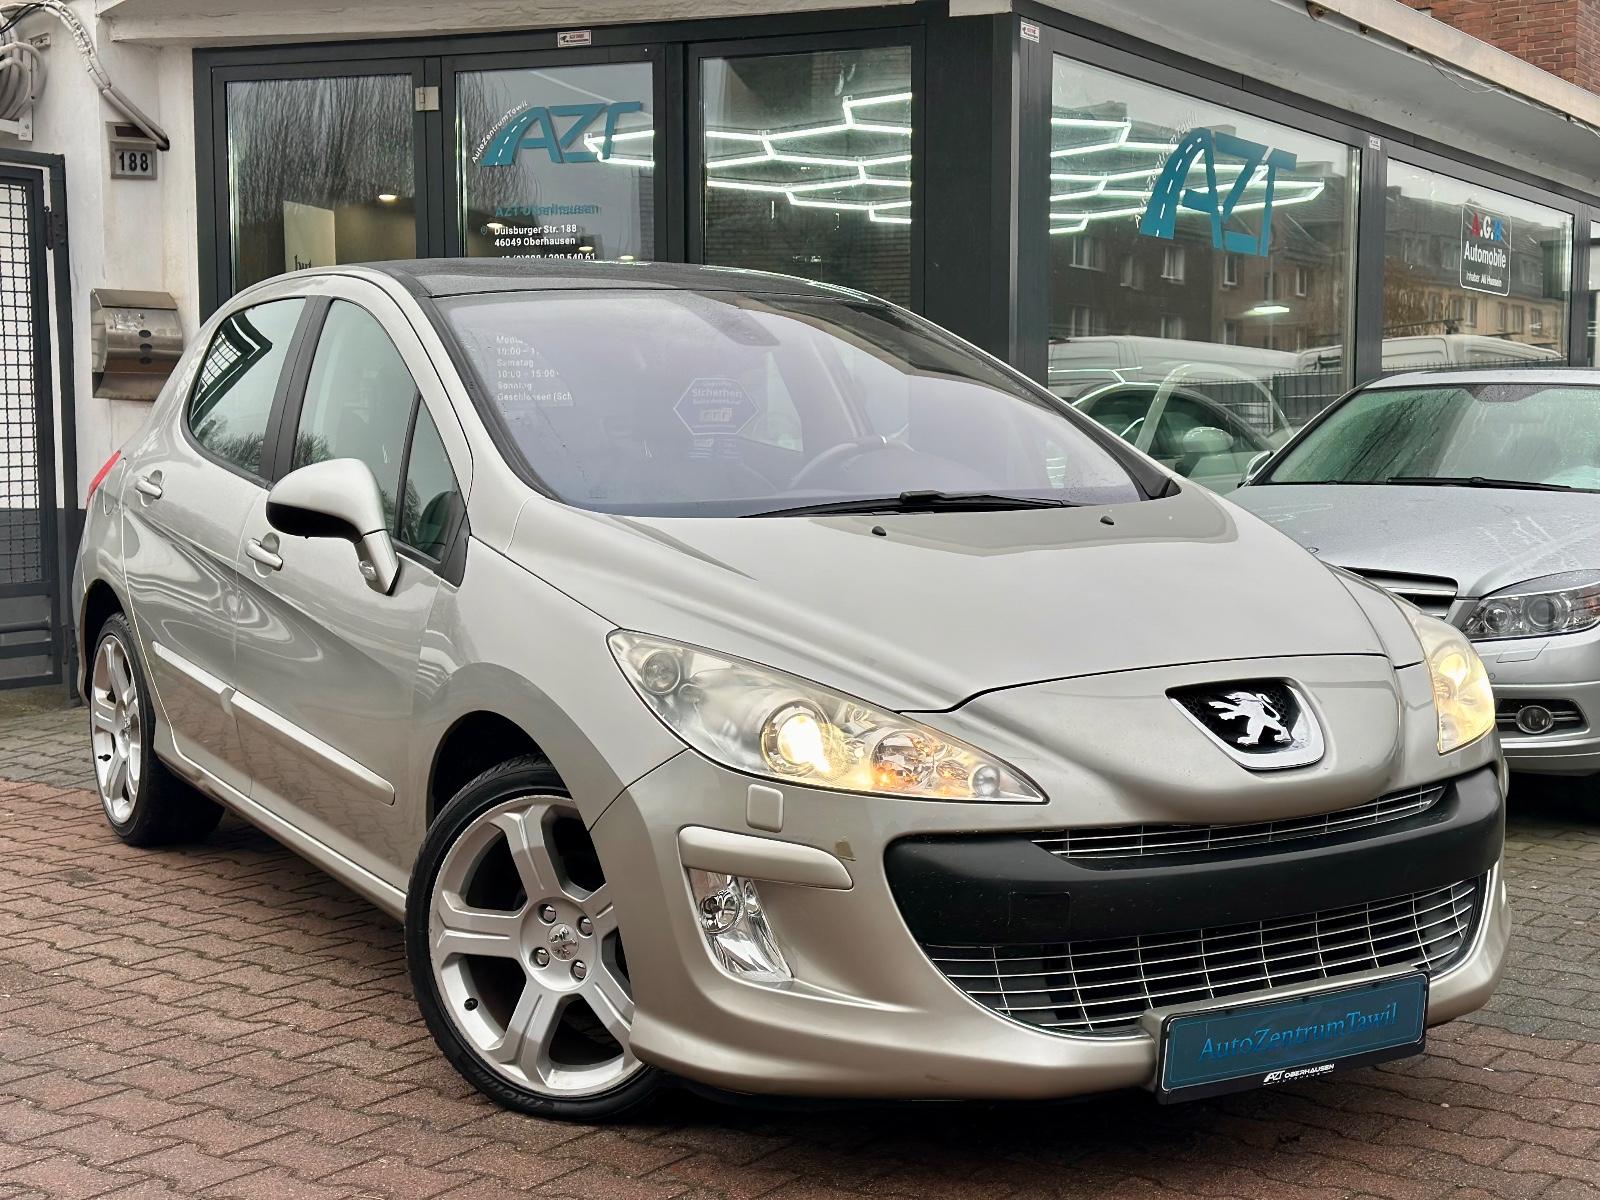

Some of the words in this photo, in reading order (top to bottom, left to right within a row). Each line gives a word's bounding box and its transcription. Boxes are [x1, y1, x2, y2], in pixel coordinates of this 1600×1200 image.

[480, 101, 643, 166] AZT
[118, 151, 149, 172] 188
[1140, 127, 1297, 257] AZT
[494, 225, 542, 236] Duisburger
[543, 224, 559, 234] Str.
[560, 224, 577, 234] 188
[494, 238, 522, 247] 46049
[523, 236, 576, 246] Oberhausen
[1463, 241, 1507, 269] Automobile
[1200, 1002, 1398, 1061] AutoZentrumTawil
[1284, 1063, 1335, 1078] OBERHAUSEN
